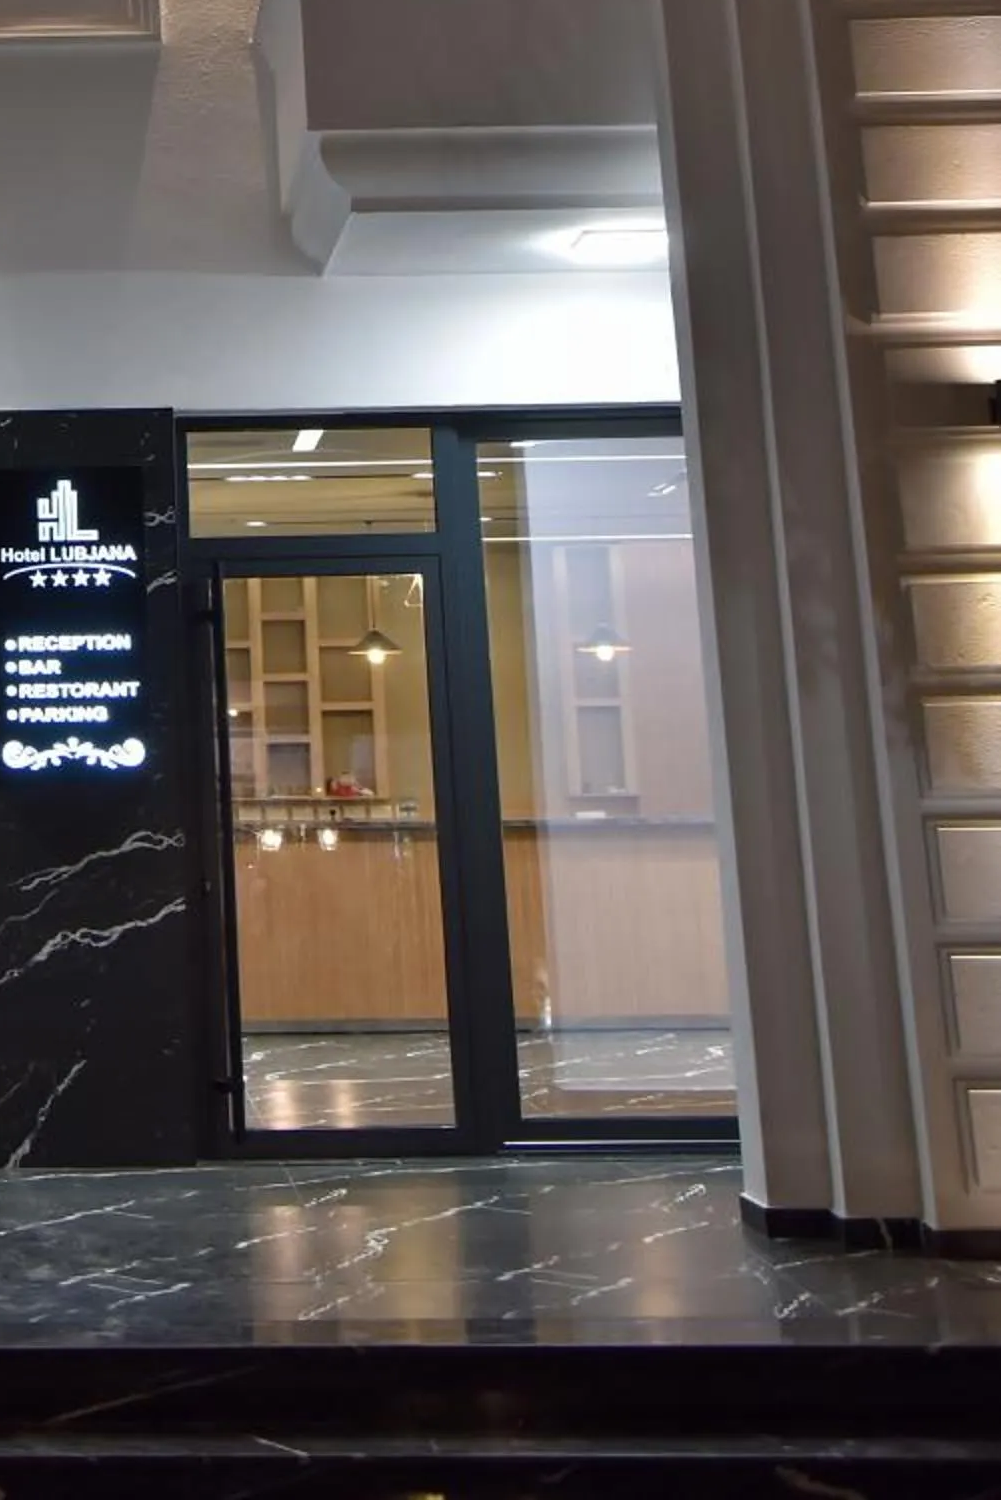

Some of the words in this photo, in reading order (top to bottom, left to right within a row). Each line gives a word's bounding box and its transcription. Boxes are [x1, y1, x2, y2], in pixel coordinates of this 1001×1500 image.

[0, 547, 46, 563] Hotel
[50, 544, 138, 562] LUBJANA
[17, 633, 132, 653] RECEPTION
[18, 659, 62, 676] BAR
[18, 681, 141, 699] RESTORANT
[18, 706, 109, 723] PARKING
